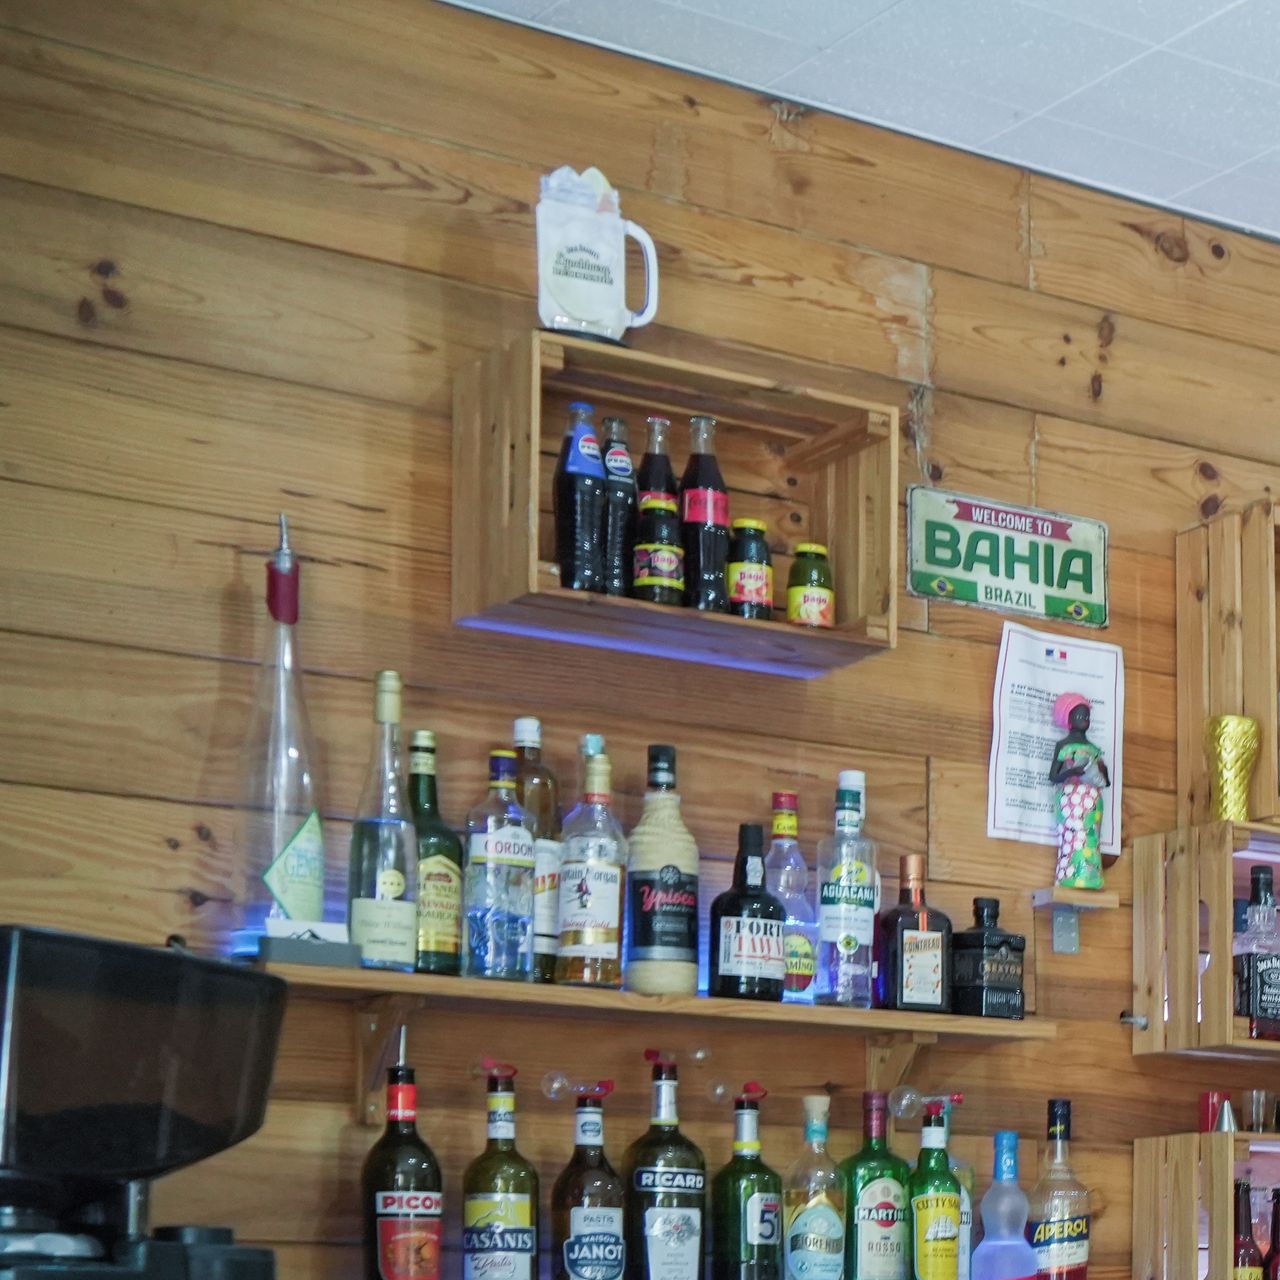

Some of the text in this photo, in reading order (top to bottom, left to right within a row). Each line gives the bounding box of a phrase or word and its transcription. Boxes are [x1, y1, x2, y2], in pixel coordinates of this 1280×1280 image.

[971, 507, 1052, 536] WELCOME TO
[652, 555, 679, 569] pago
[925, 519, 1093, 595] BAHIA
[739, 570, 765, 583] pago
[803, 594, 828, 606] pago
[984, 585, 1036, 610] BRAZIL
[823, 884, 874, 901] AGUACANA
[641, 1171, 704, 1189] RICARD
[383, 1196, 442, 1210] PICON
[916, 1197, 947, 1212] CUTTY
[583, 1214, 614, 1224] PASTIS
[1033, 1218, 1088, 1243] APEROL
[464, 1230, 532, 1249] CASANIS
[868, 1241, 901, 1252] ROSSO
[569, 1244, 623, 1260] JANOT
